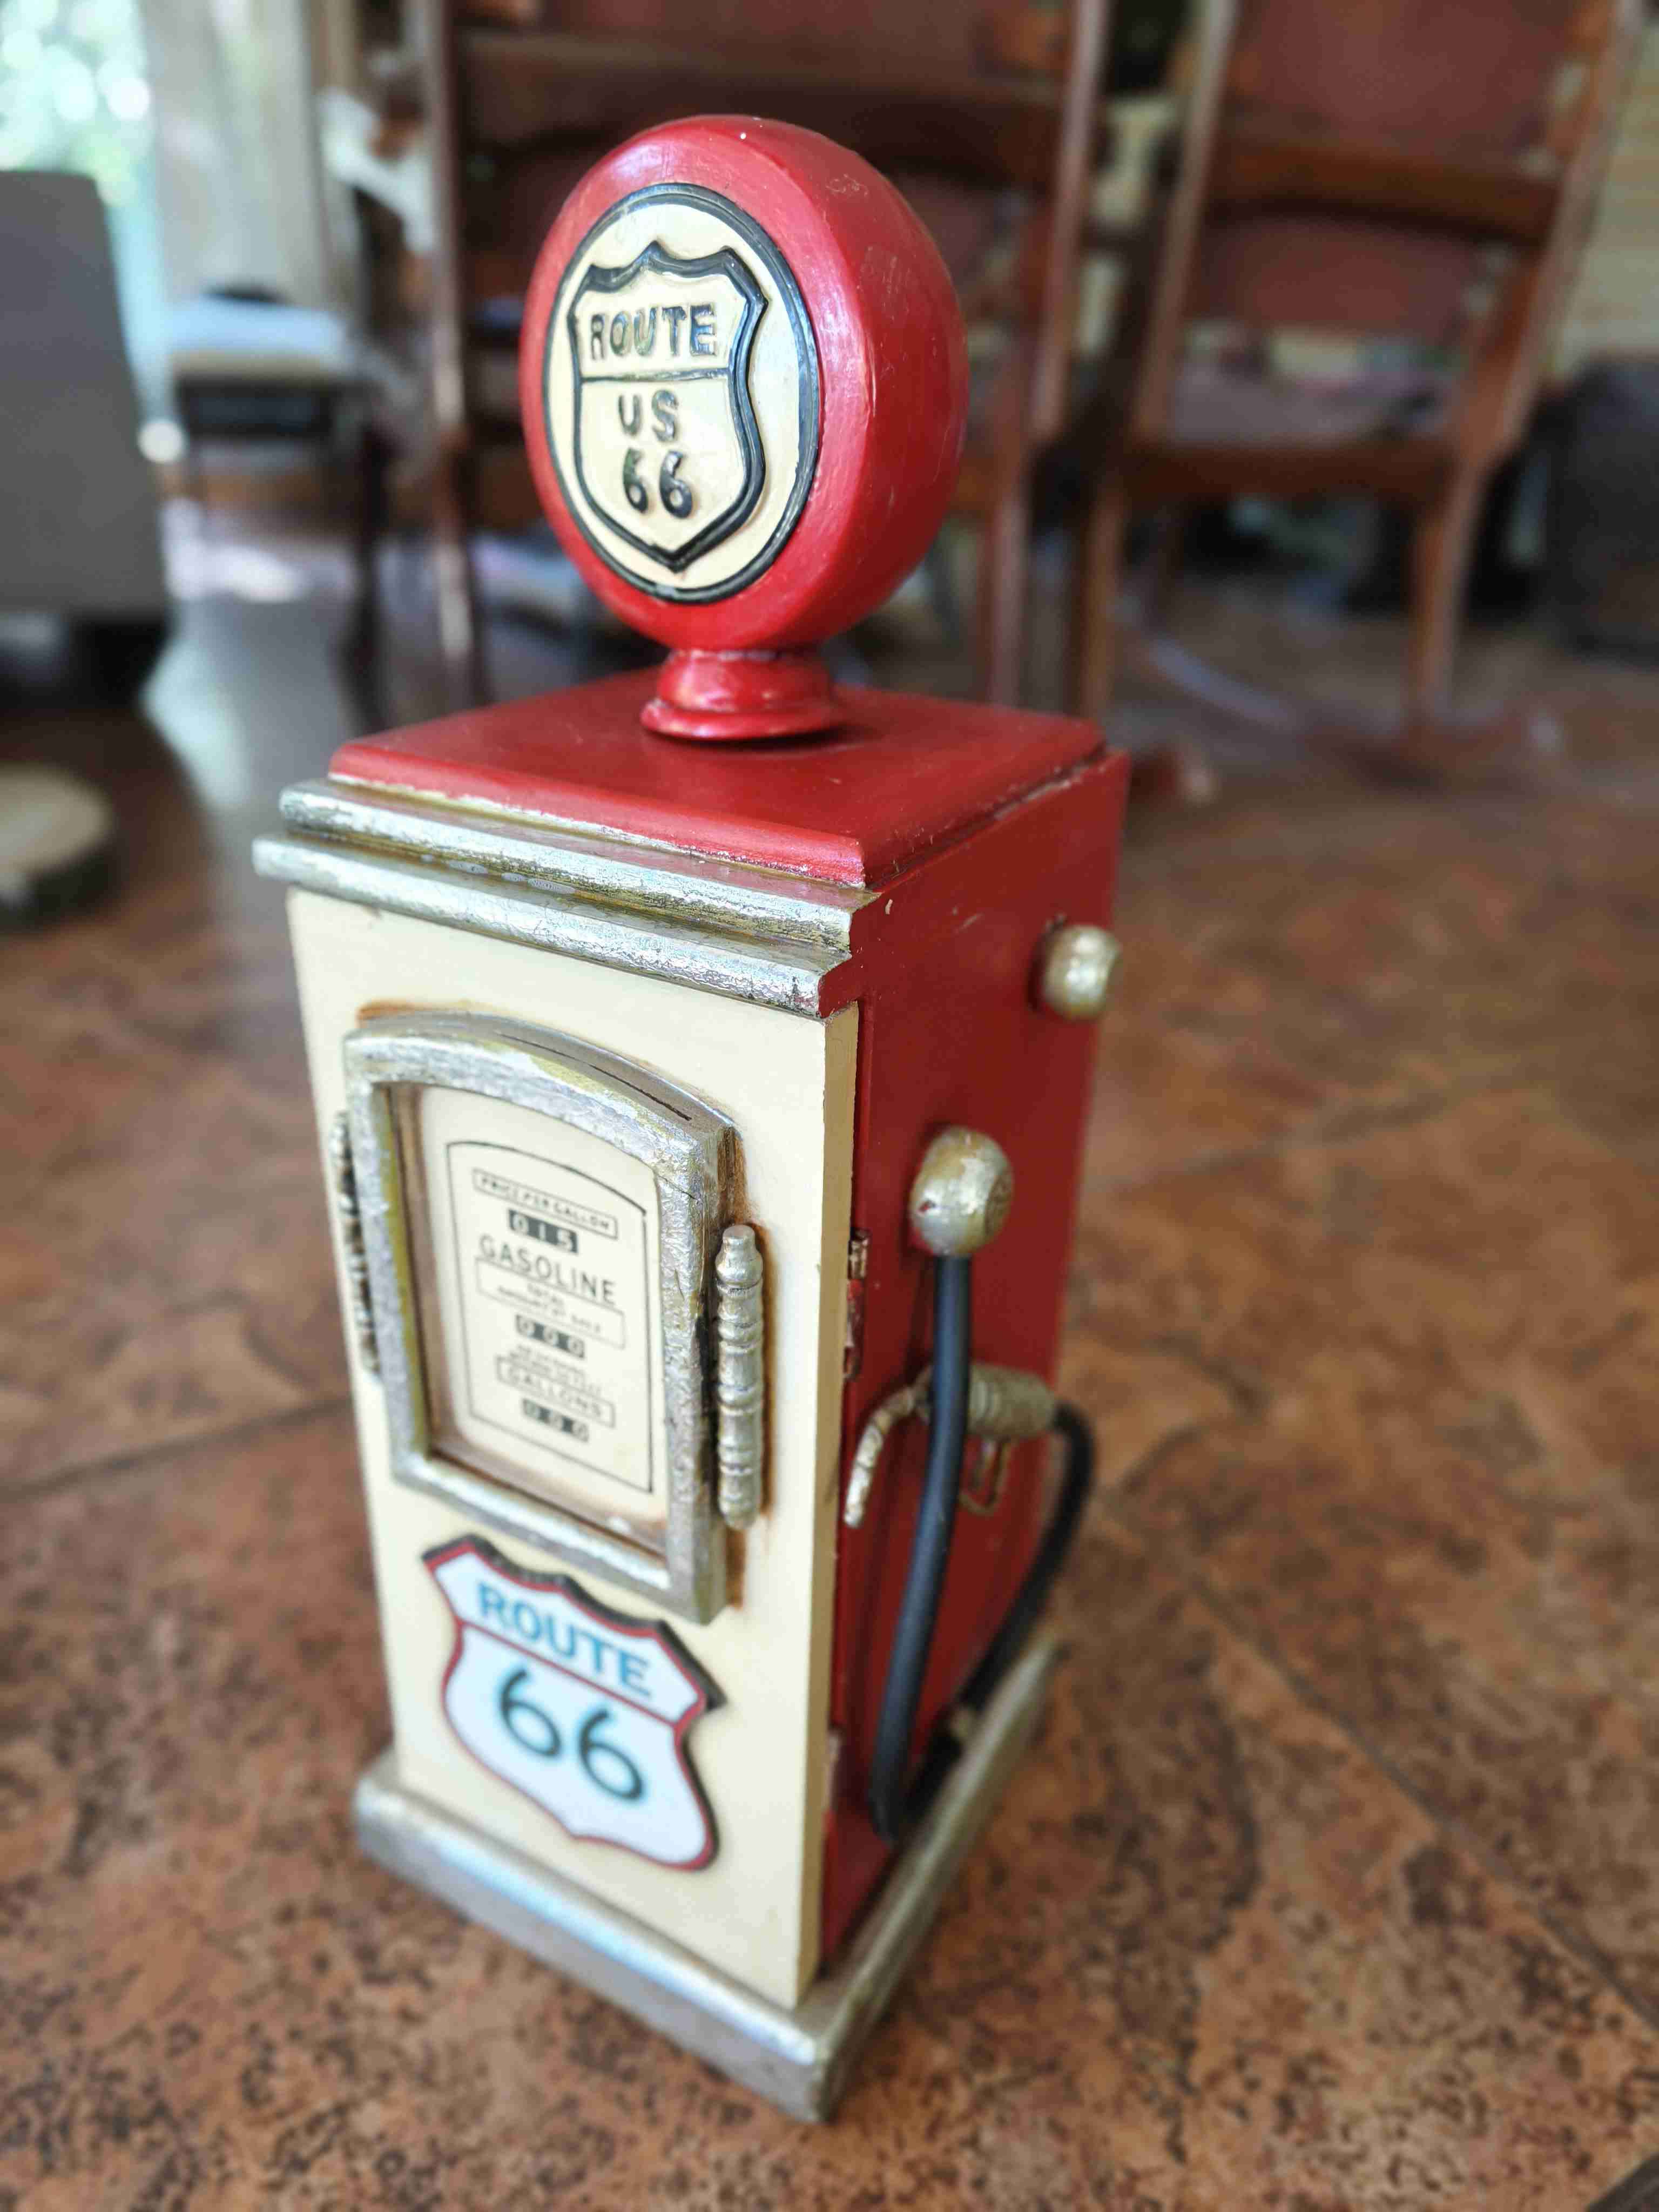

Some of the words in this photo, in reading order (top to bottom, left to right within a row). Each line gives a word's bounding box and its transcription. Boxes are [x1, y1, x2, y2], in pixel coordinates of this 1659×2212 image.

[589, 303, 718, 362] ROUTE
[618, 390, 680, 443] US
[622, 447, 693, 519] 66
[478, 1234, 617, 1305] GASOLINE
[477, 1581, 652, 1700] ROUTE
[498, 1668, 644, 1802] 66
